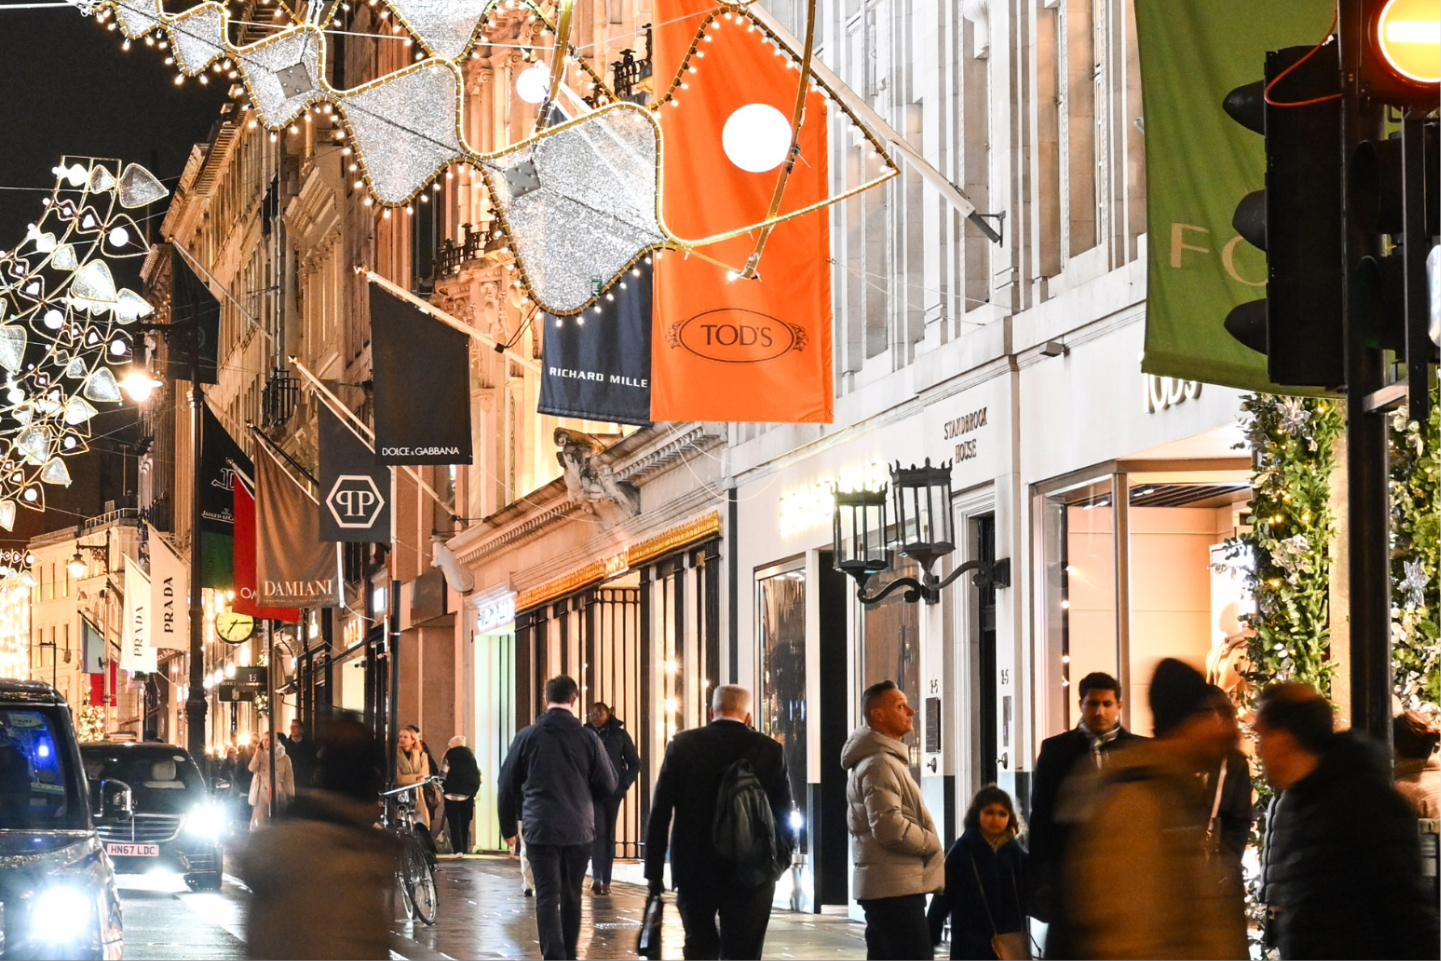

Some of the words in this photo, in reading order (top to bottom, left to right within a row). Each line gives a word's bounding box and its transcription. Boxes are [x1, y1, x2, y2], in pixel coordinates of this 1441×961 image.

[700, 324, 773, 348] TOD'S
[549, 366, 604, 382] RICHARD
[610, 374, 649, 389] MILLE
[943, 406, 988, 440] STANDBROOK
[382, 447, 410, 456] DOLCE
[414, 446, 460, 456] GABBANA
[955, 438, 977, 464] HOUSE
[263, 579, 333, 597] DAMIANI
[163, 576, 174, 634] PRADA
[133, 605, 144, 657] PRADA
[110, 845, 135, 855] HN67
[137, 845, 156, 855] LDC
